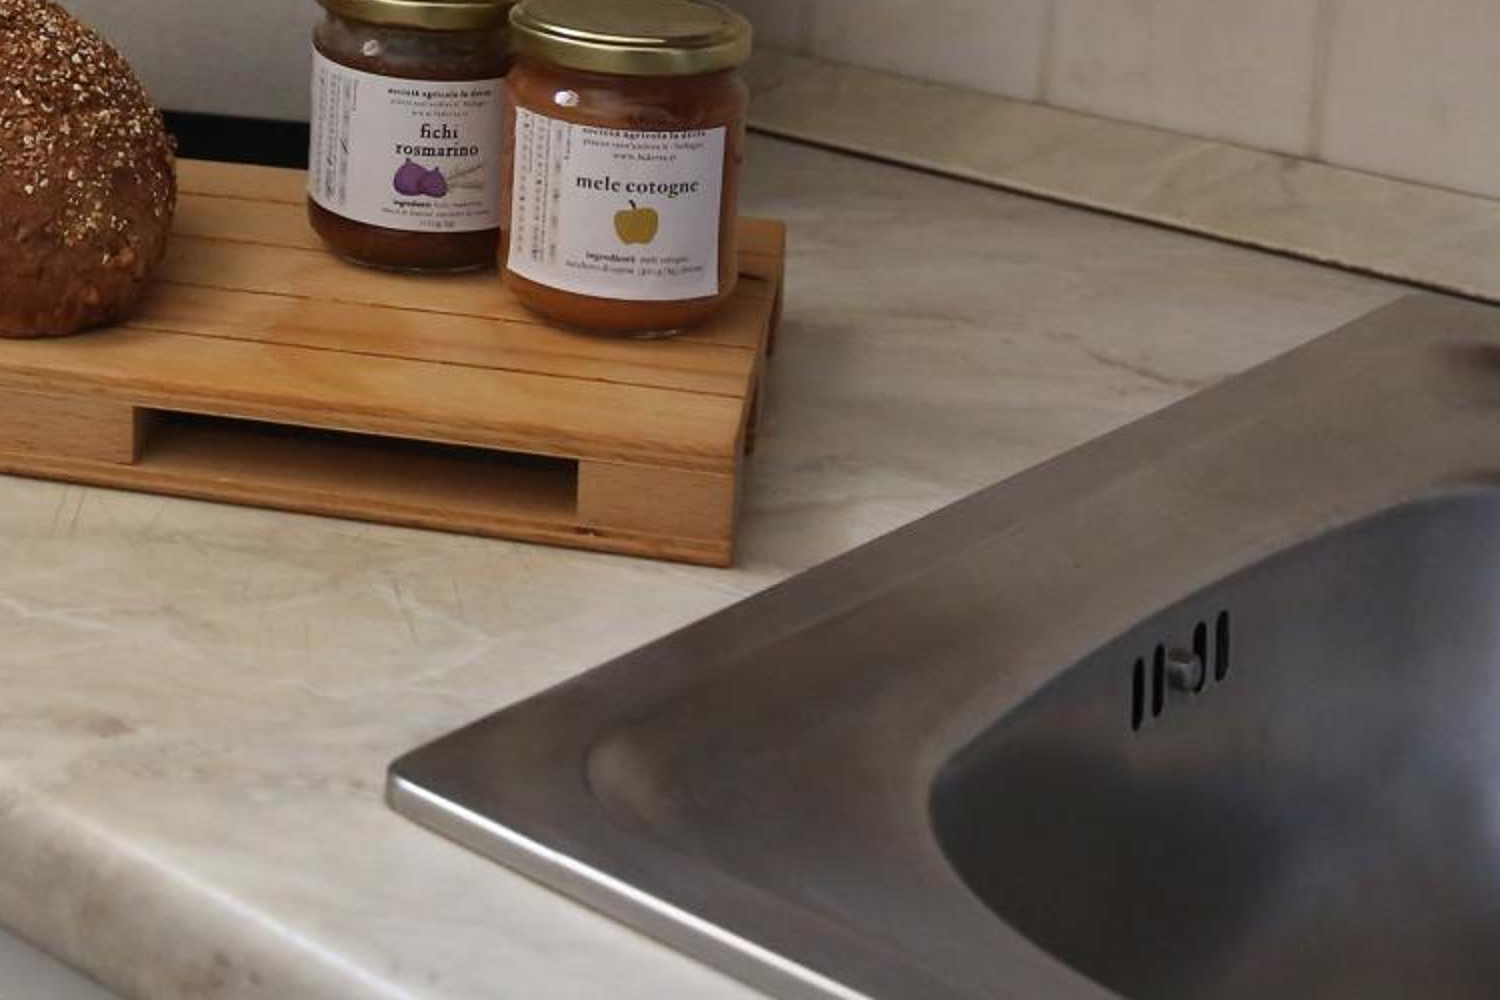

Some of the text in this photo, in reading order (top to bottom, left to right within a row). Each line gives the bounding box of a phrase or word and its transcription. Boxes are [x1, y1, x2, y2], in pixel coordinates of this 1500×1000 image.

[420, 124, 458, 139] fichi
[396, 142, 479, 156] rosmarino
[576, 175, 699, 198] mele cotogne
